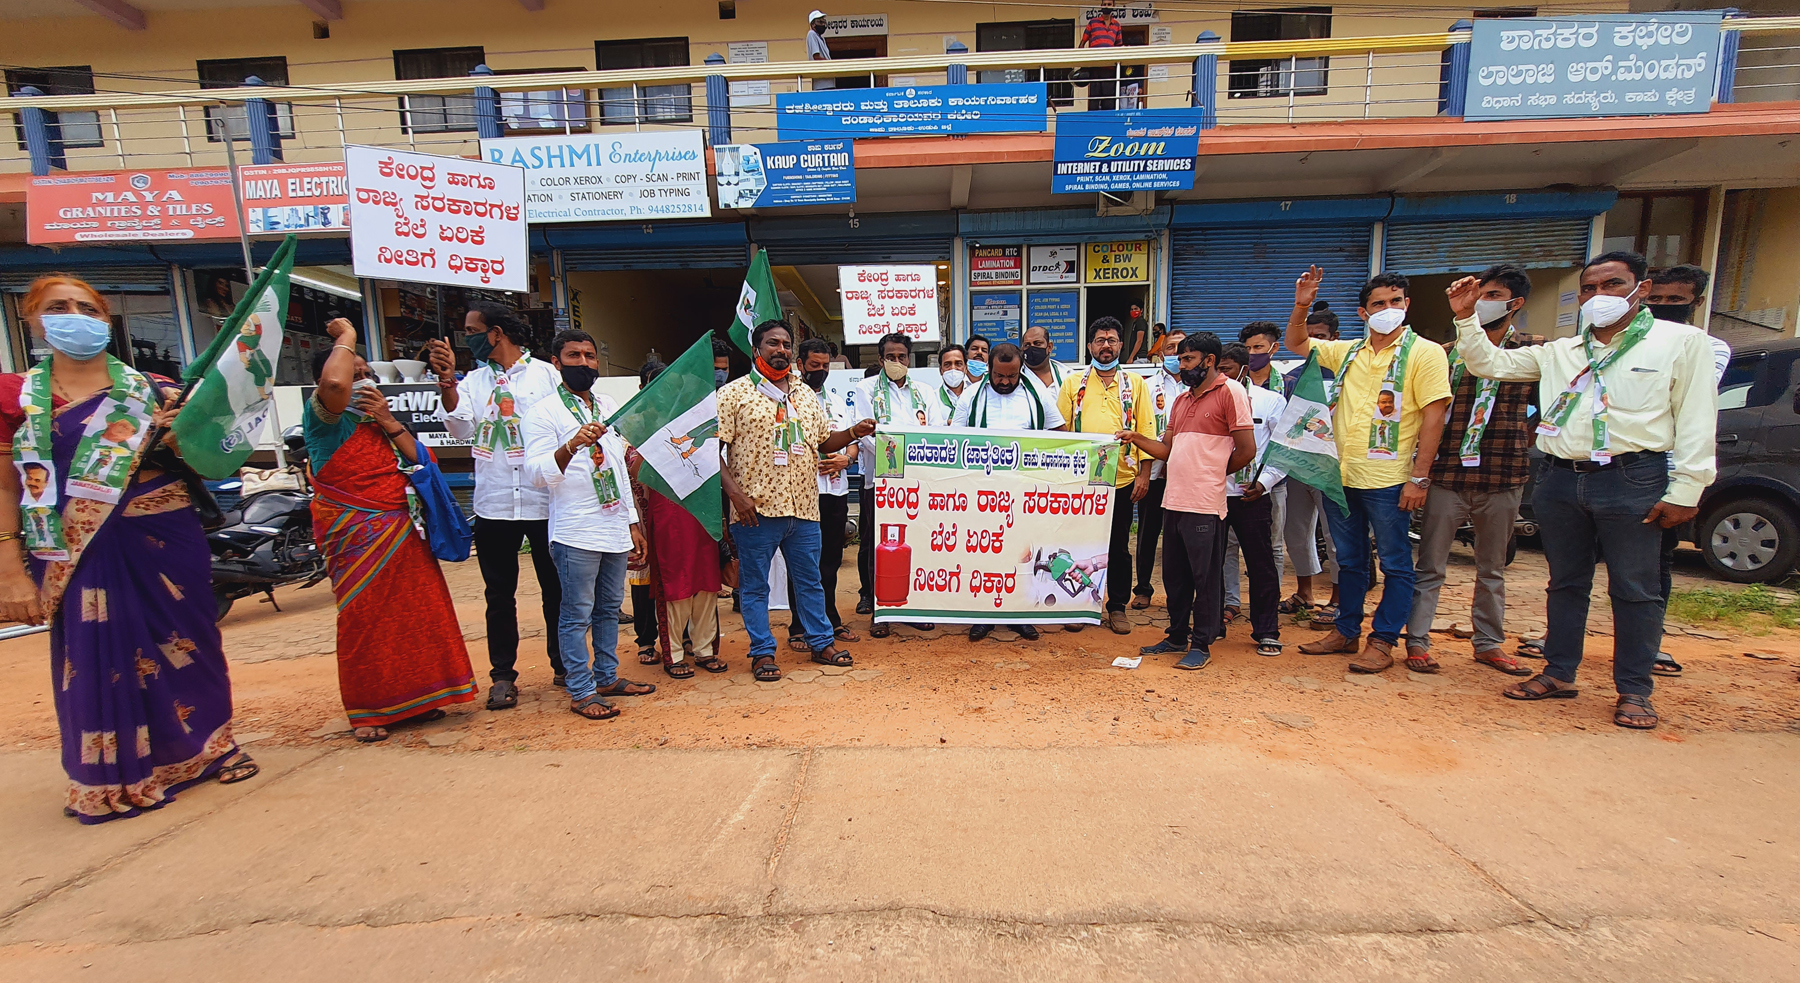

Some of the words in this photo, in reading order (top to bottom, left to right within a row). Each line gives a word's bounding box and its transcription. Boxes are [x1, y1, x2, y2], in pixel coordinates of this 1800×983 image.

[1500, 22, 1599, 51] ಶಾಸಕರ
[1478, 62, 1555, 86] ಲಾಲಾಜಿ
[860, 99, 889, 112] ಮತ್ತು
[893, 97, 943, 109] ತಾಲೂಕು
[1481, 93, 1522, 109] ವಿಧಾನ
[1527, 92, 1557, 106] ಸಭಾ
[1624, 88, 1660, 103] ಕಾಪು
[1665, 87, 1697, 107] ಕ್ಷೇತ್ರ
[1084, 136, 1167, 159] Zoom
[489, 142, 602, 170] RASHMI
[608, 141, 699, 173] Enterprises
[766, 154, 798, 170] KAUP
[800, 152, 850, 168] CURTAIN
[378, 155, 437, 189] ಕೇಂದ್ರ
[447, 169, 497, 192] ಹಾಗೂ
[1057, 161, 1101, 175] INTERNET
[1101, 163, 1109, 173] &
[1110, 160, 1145, 173] UTILITY
[1146, 158, 1192, 171] SERVICES
[539, 175, 572, 188] COLOR
[573, 174, 604, 186] XEROX
[614, 173, 638, 185] COPY
[645, 172, 669, 184] SCAN
[675, 171, 701, 182] PRINT
[1133, 173, 1168, 181] LAMINATION,
[245, 179, 282, 200] MAYA
[570, 189, 625, 202] STATIONERY
[639, 187, 657, 199] JOB
[658, 186, 691, 199] TYPING
[1085, 183, 1110, 191] BINDING,
[1110, 182, 1131, 190] GAMES,
[90, 190, 185, 203] MAYA
[355, 186, 406, 219] ರಾಜ್ಯ
[414, 190, 521, 222] ಸರಕಾರಗಳ
[1504, 194, 1517, 205] 18
[58, 205, 143, 219] GRANITES
[146, 205, 161, 218] &
[166, 203, 215, 216] TILES
[527, 206, 572, 219] Electrical
[574, 205, 628, 219] Contractor,
[629, 204, 646, 216] Ph:
[647, 203, 705, 215] 9448252814
[1279, 201, 1292, 212] 17
[170, 219, 181, 227] &
[849, 218, 861, 229] 15
[79, 231, 138, 239] Wholesale
[142, 230, 188, 238] Dealers
[394, 218, 429, 240] ಬೆಲೆ
[438, 224, 486, 246] ಏರಿಕೆ
[975, 248, 1003, 257] PANCARD
[1005, 248, 1018, 256] RTC
[1092, 243, 1143, 254] COLOUR
[377, 246, 437, 269] ನೀತಿಗೆ
[447, 252, 506, 284] ಧಿಕ್ಕಾರ
[978, 259, 1015, 269] LAMINATION
[1101, 254, 1111, 265] &
[1113, 254, 1133, 264] BW
[857, 269, 889, 287] ಕೇಂದ್ರ
[894, 272, 921, 283] ಹಾಗೂ
[973, 271, 994, 280] SPIRAL
[995, 270, 1020, 280] BINDING
[1093, 266, 1139, 281] XEROX
[845, 290, 874, 307] ರಾಜ್ಯ
[877, 286, 935, 300] ಸರಕಾರಗಳ
[867, 304, 886, 317] ಬೆಲೆ
[891, 303, 917, 317] ಏರಿಕೆ
[858, 321, 891, 335] ನೀತಿಗೆ
[907, 437, 958, 464] ಜನತಾದಳ
[1023, 449, 1039, 468] ಕಾಪು
[875, 478, 920, 520] ಕೇಂದ್ರ
[929, 488, 969, 513] ಹಾಗೂ
[977, 489, 1015, 528] ರಾಜ್ಯ
[1023, 484, 1109, 516] ಸರಕಾರಗಳ
[930, 522, 958, 553] ಬೆಲೆ
[966, 525, 1005, 554] ಏರಿಕೆ
[913, 564, 962, 593] ನೀತಿಗೆ
[969, 566, 1017, 608] ಧಿಕ್ಕಾರ
